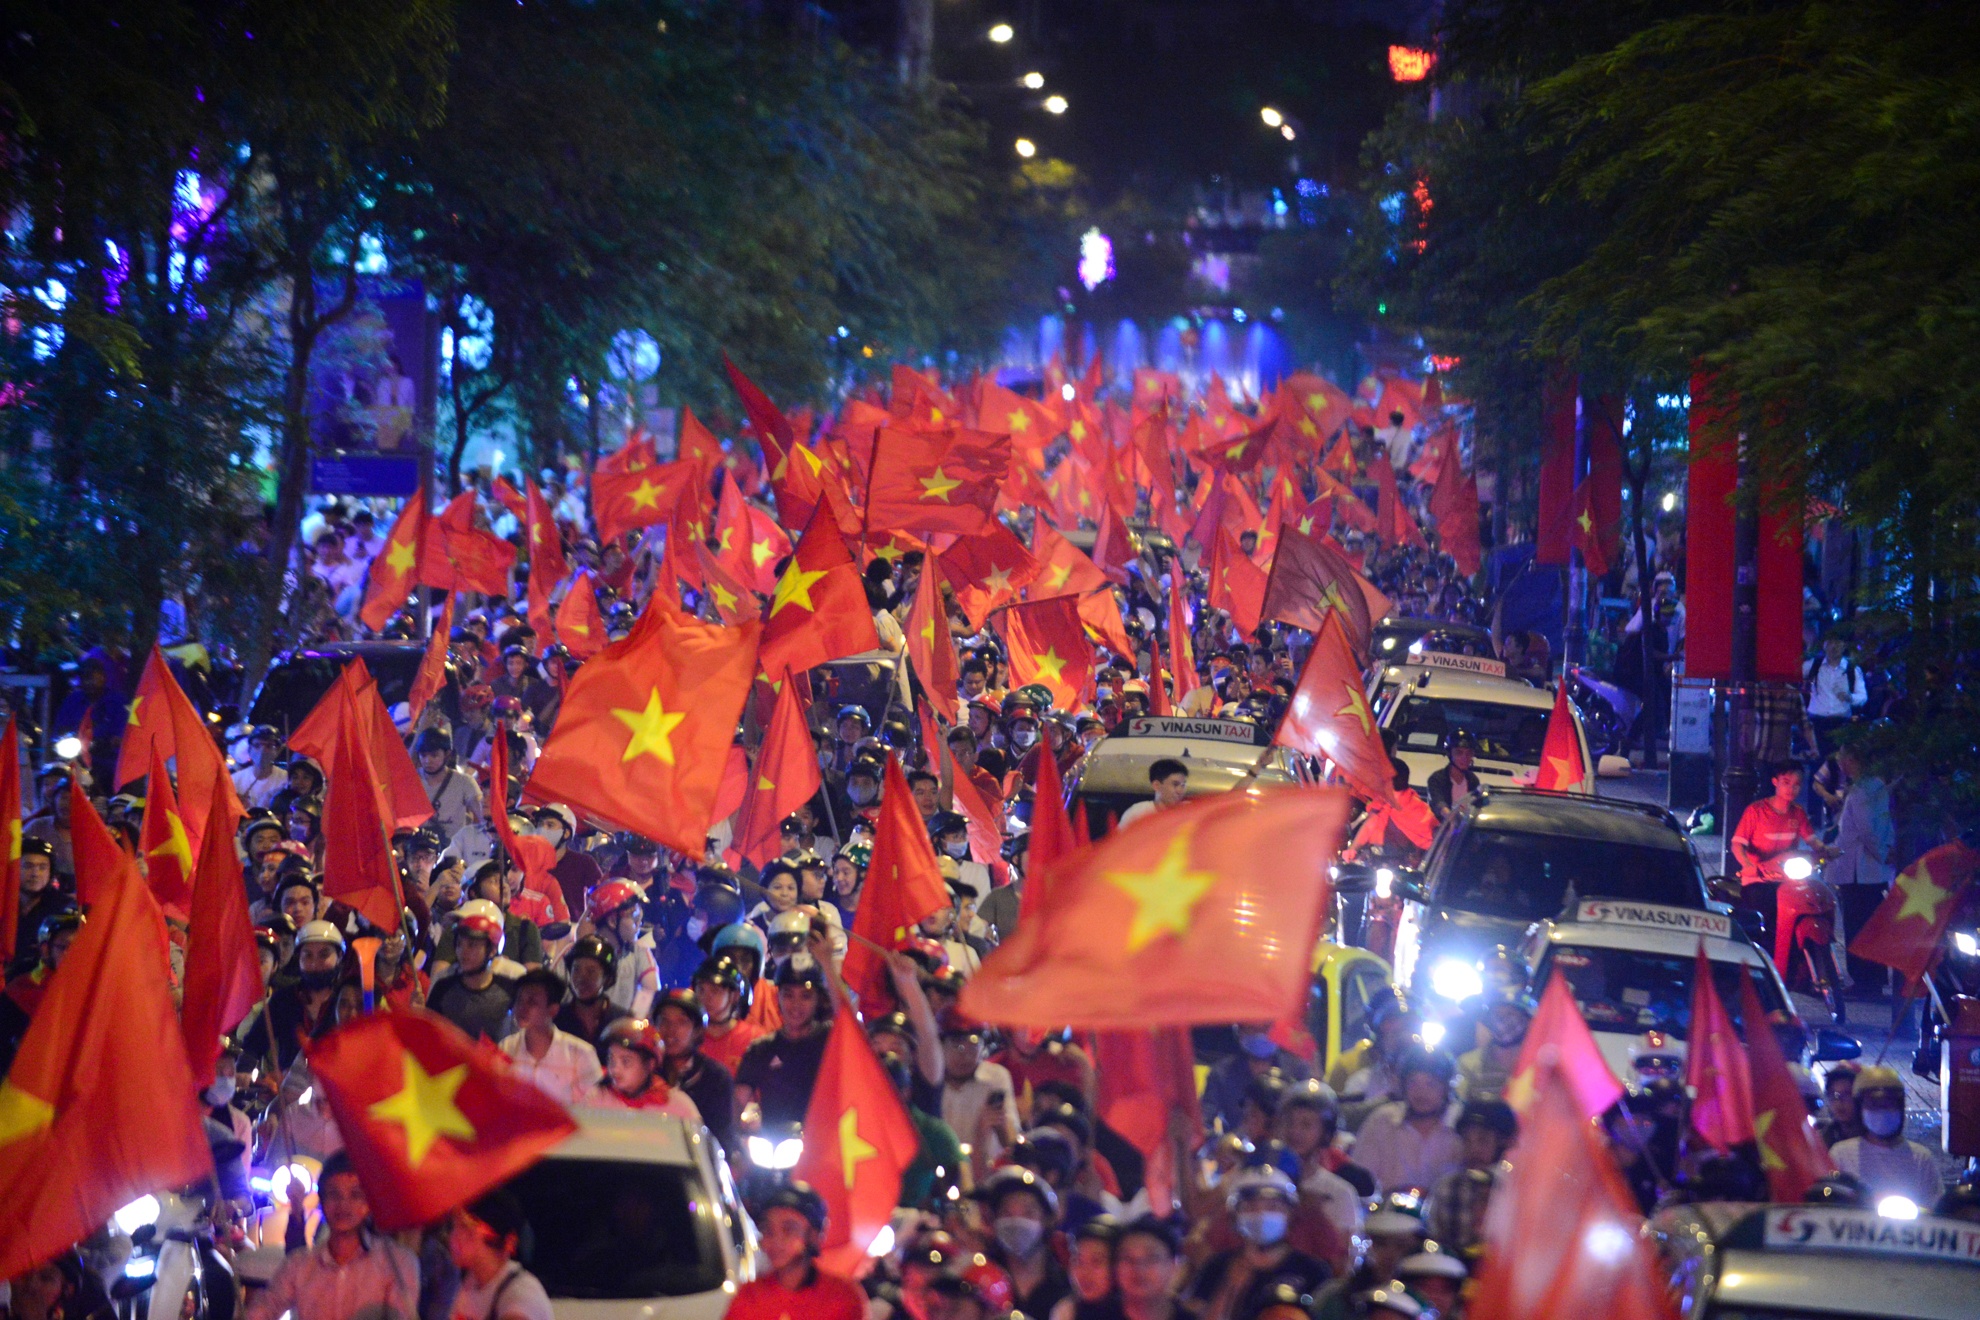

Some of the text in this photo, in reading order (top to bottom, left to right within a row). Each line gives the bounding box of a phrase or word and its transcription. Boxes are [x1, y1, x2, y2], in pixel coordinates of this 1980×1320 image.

[1432, 655, 1504, 675] VINASUN TAXI
[1161, 721, 1252, 739] VINASUN TAXI
[1615, 906, 1727, 932] VINASUN TAXI
[1828, 1217, 1958, 1252] VINASUN
